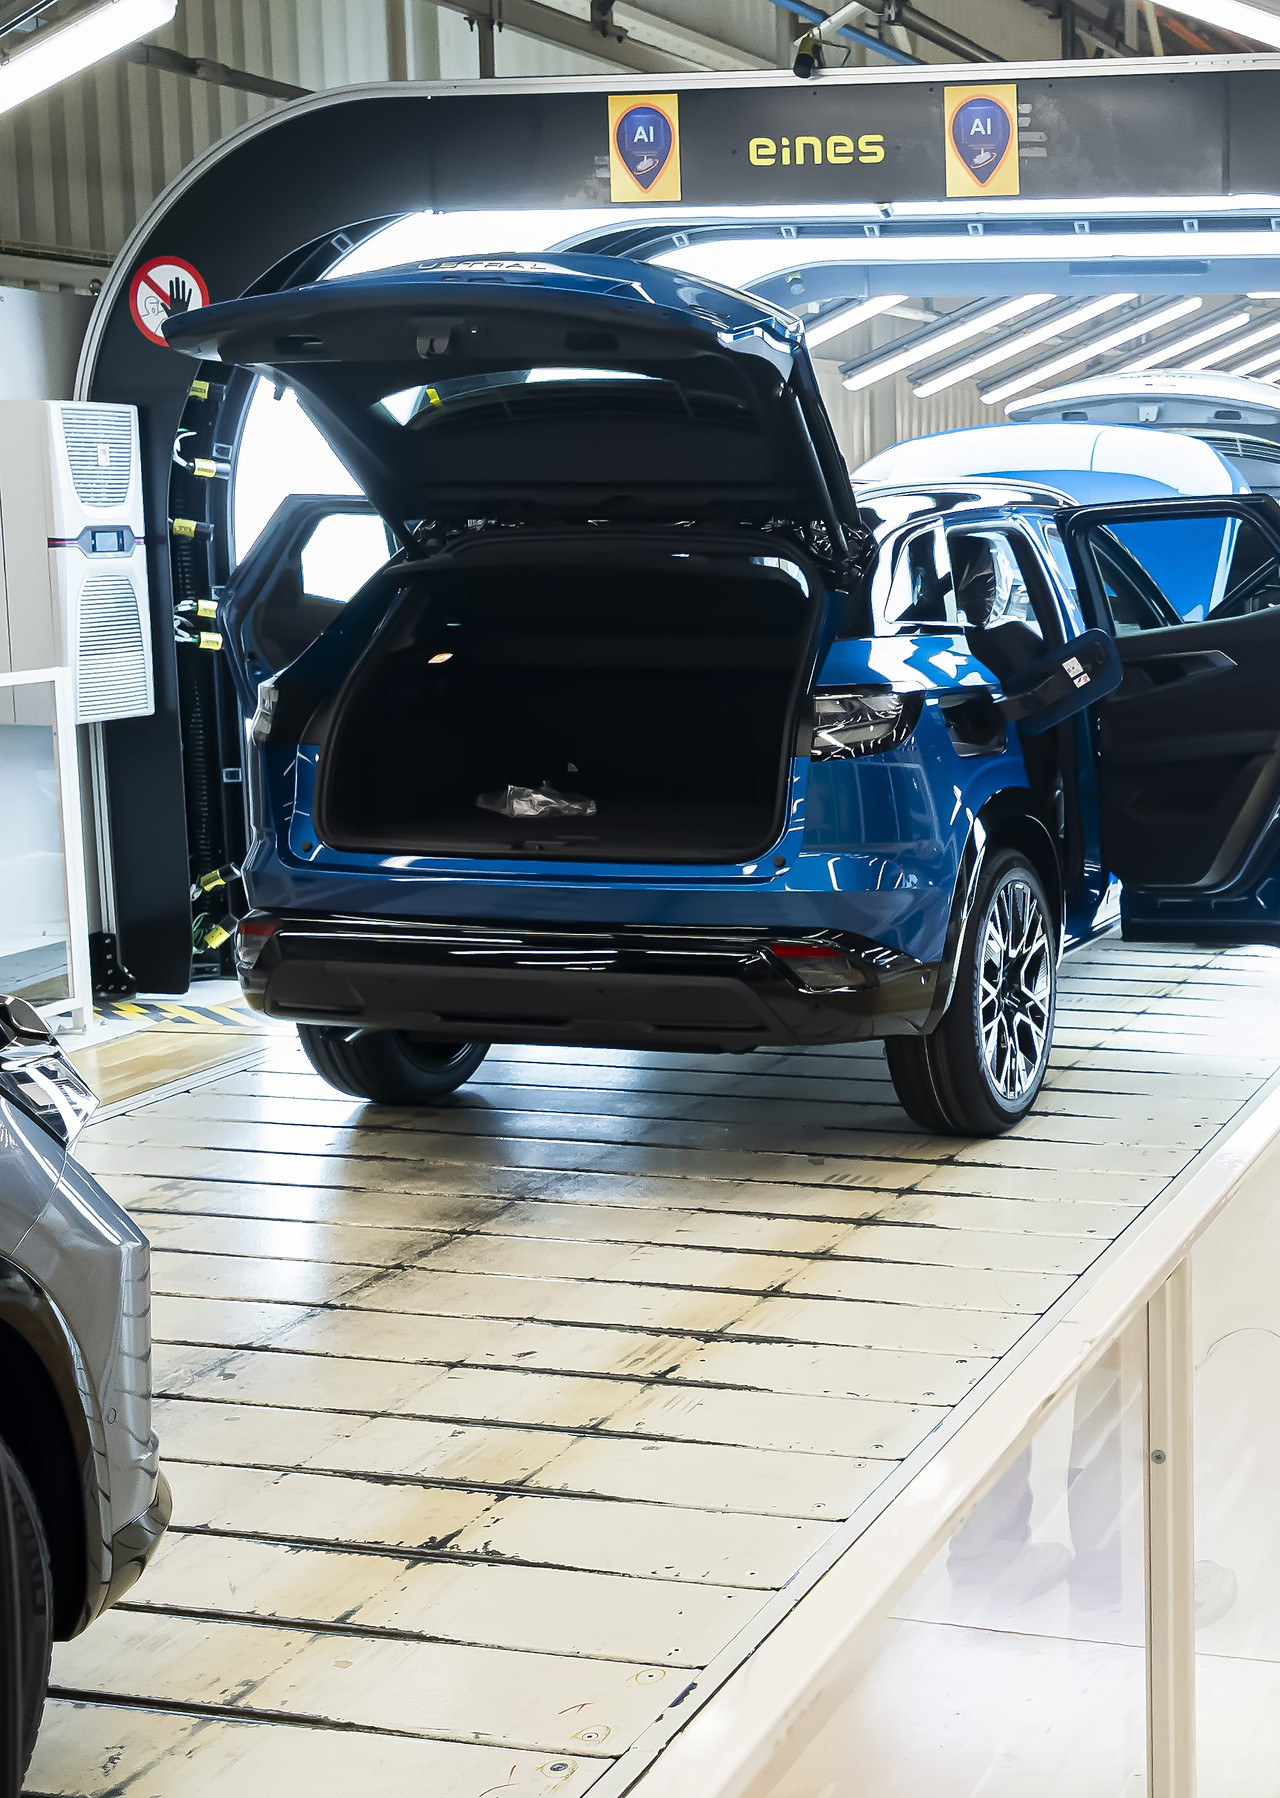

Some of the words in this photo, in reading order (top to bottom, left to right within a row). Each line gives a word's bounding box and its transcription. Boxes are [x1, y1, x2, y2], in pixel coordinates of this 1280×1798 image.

[633, 125, 655, 143] AI
[969, 117, 992, 136] AI
[748, 134, 885, 166] eines
